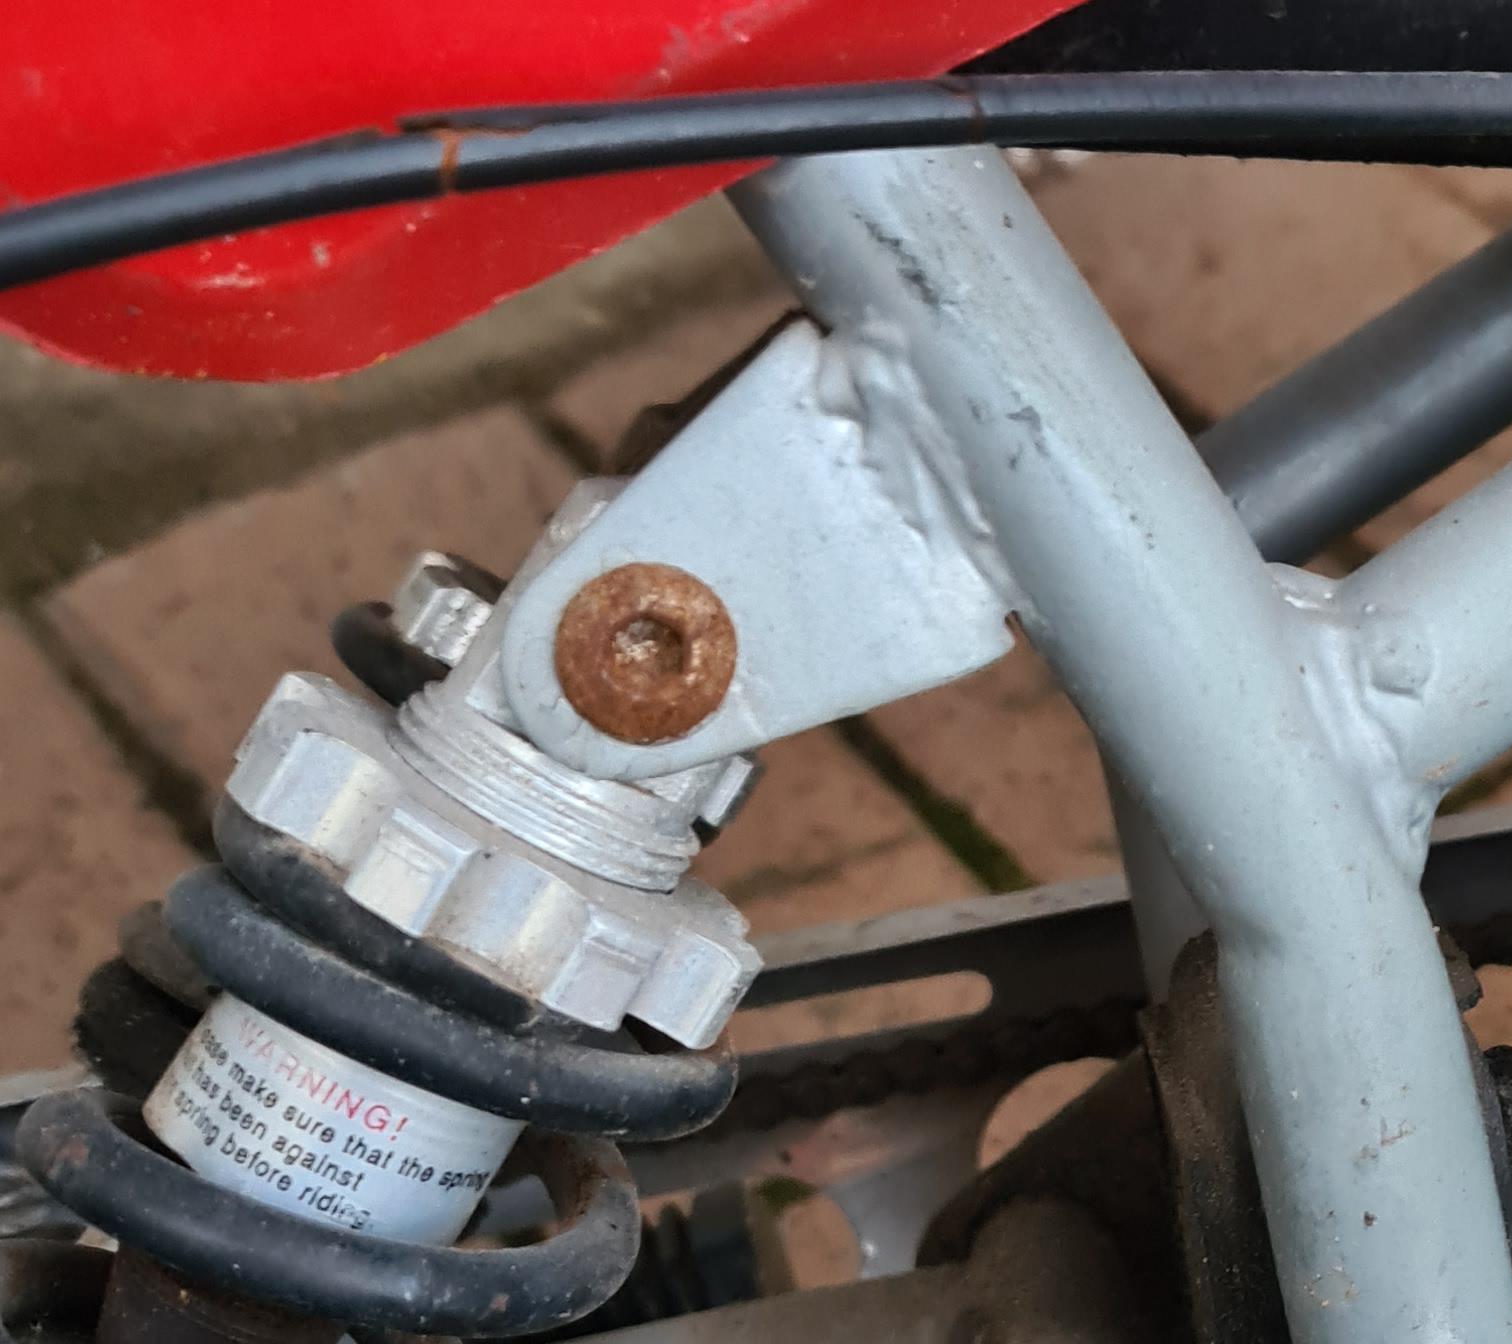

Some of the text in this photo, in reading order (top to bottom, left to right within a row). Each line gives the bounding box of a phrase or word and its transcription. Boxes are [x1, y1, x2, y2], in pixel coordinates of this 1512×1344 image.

[191, 1060, 366, 1192] has been against
[227, 1061, 279, 1109] make
[283, 1104, 336, 1144] sure
[341, 1133, 394, 1170] that
[397, 1156, 435, 1183] the
[239, 1018, 409, 1142] WARNING!
[219, 1131, 293, 1192] before
